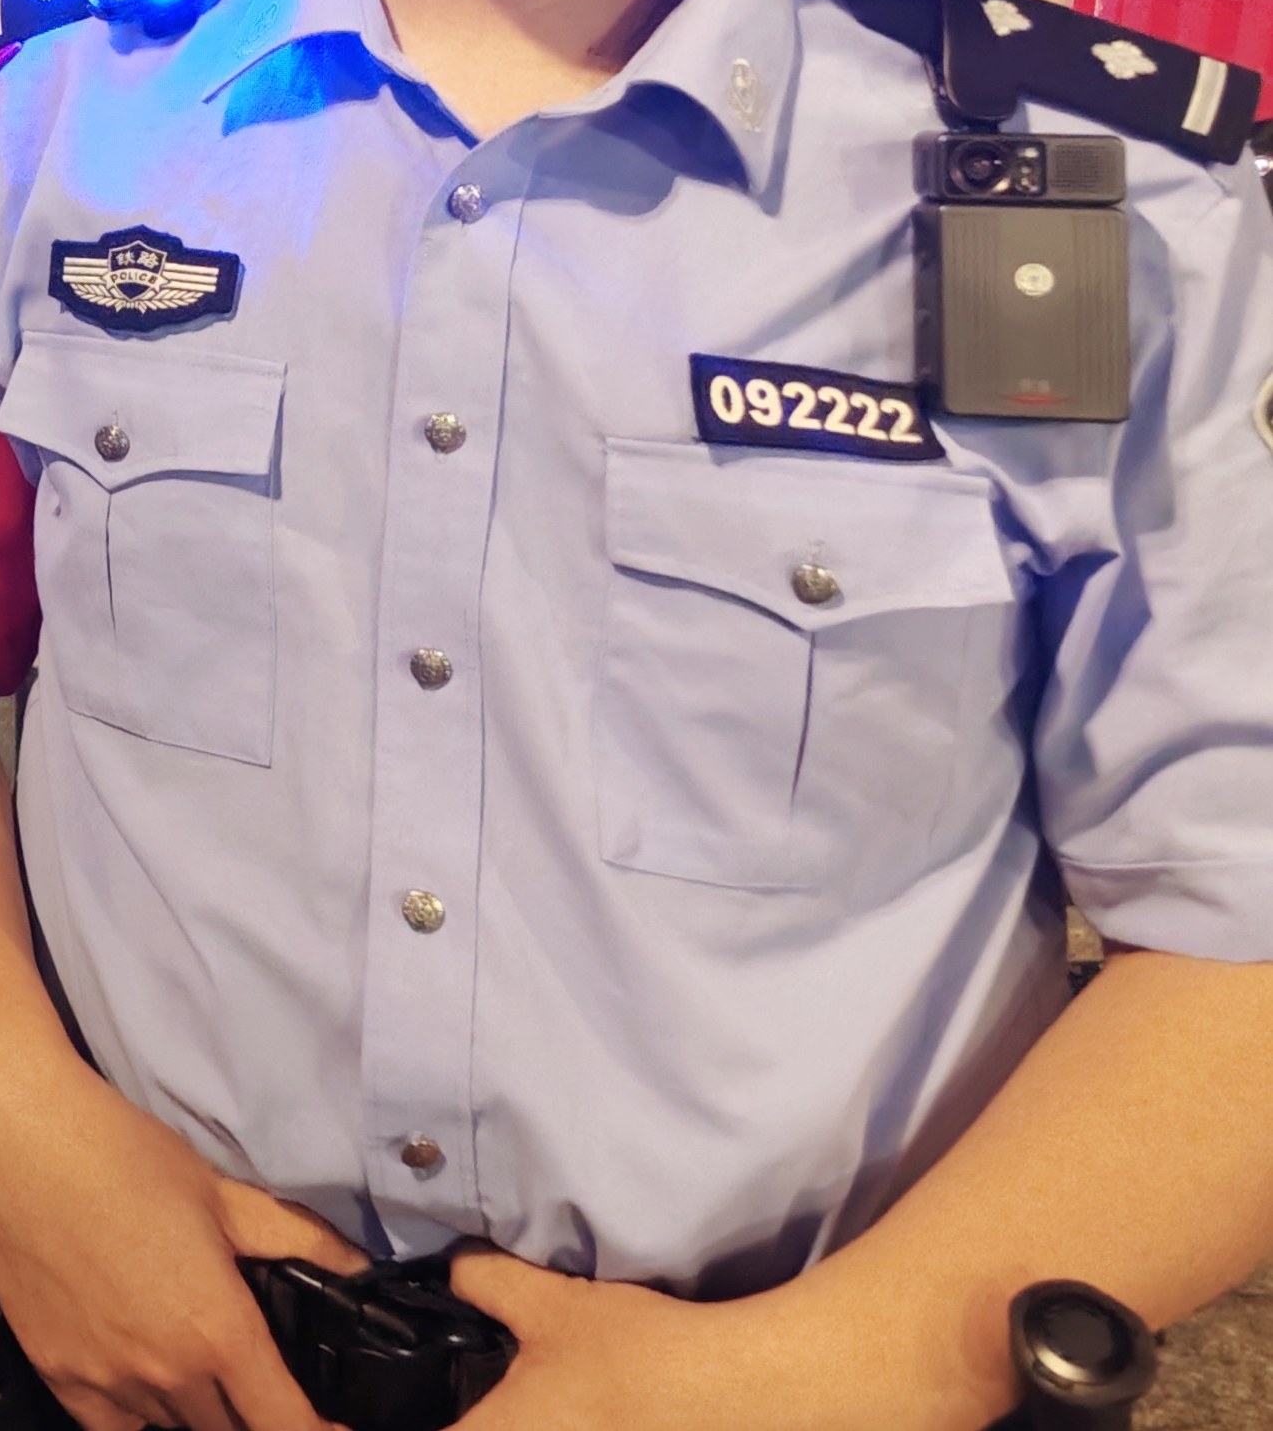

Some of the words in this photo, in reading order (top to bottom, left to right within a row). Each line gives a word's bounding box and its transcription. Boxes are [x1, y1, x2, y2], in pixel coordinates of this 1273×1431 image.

[115, 250, 160, 269] 铁路
[111, 272, 158, 285] POLICE
[709, 374, 923, 444] 092222
